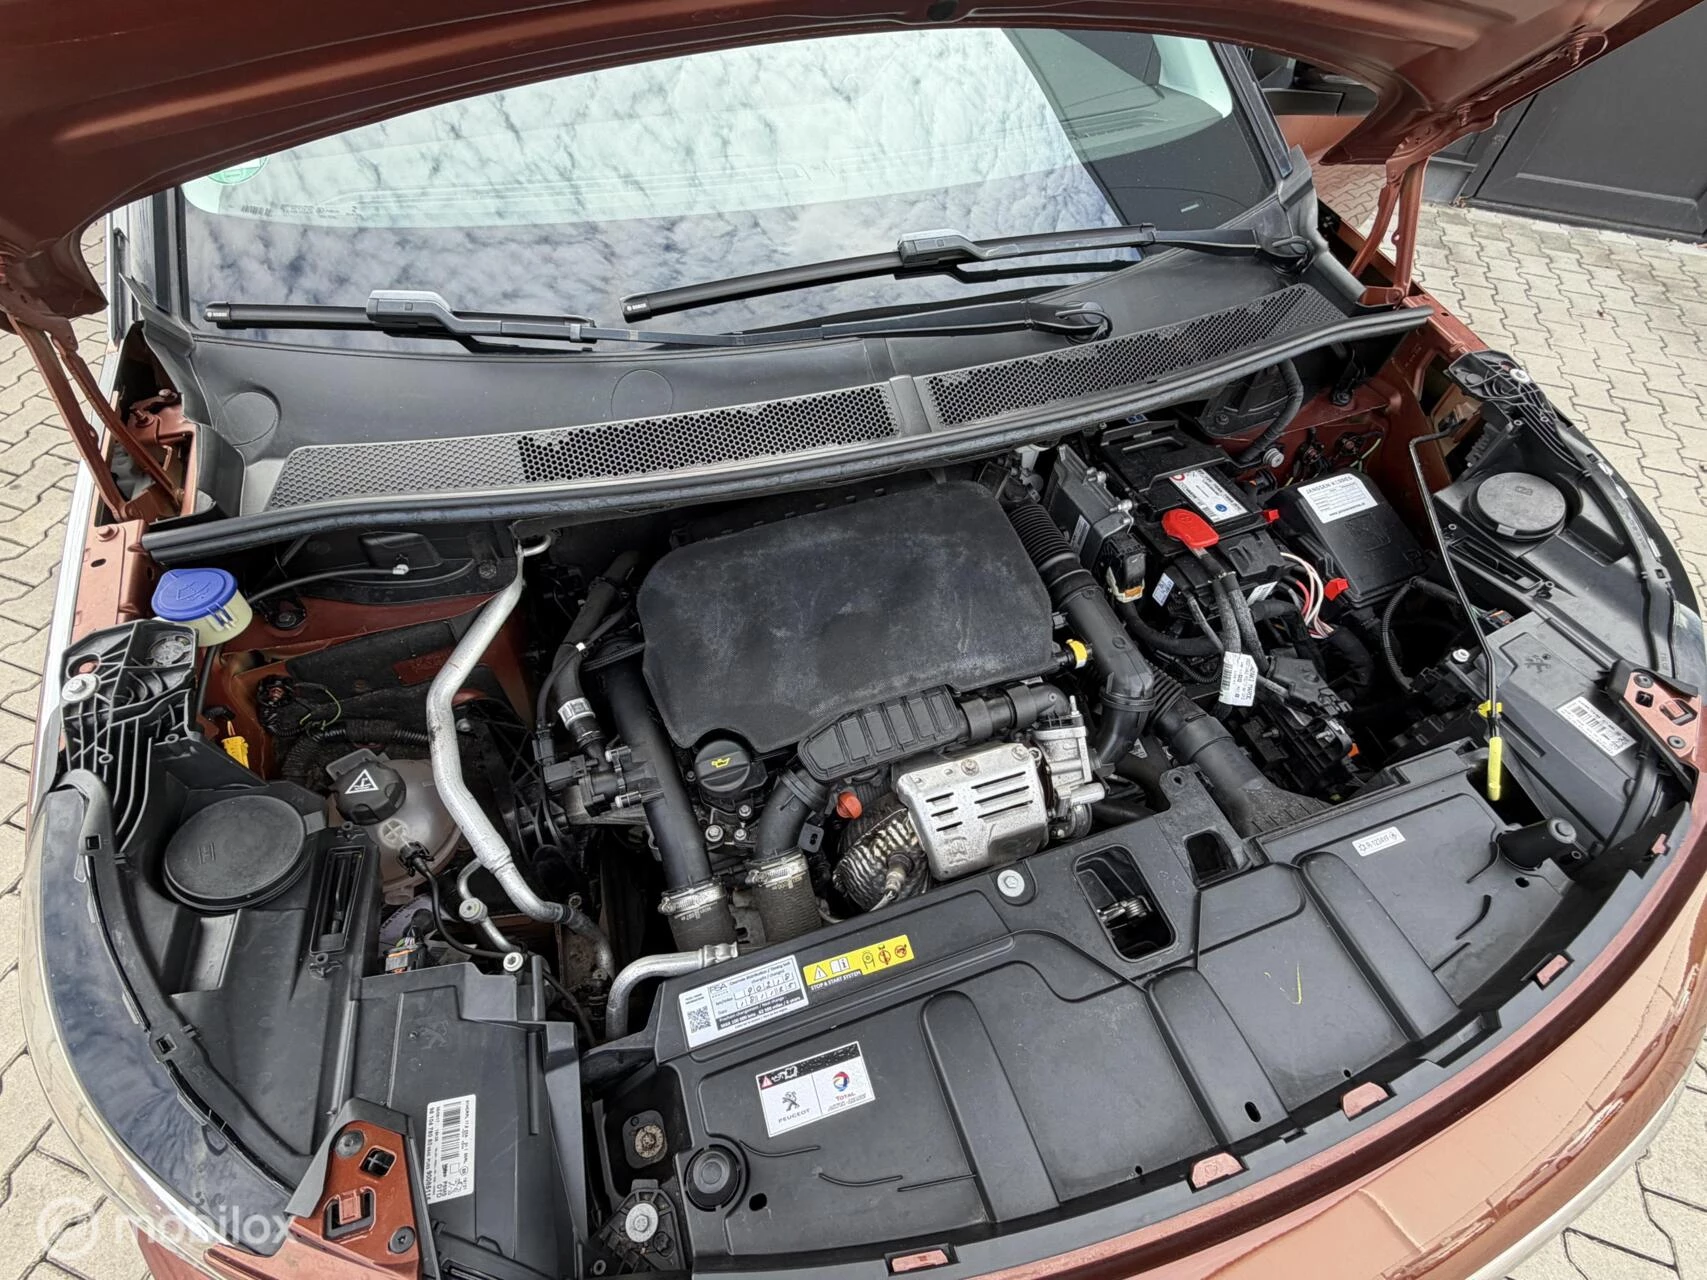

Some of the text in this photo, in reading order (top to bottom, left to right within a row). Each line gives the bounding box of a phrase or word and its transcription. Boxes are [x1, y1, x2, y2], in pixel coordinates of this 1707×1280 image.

[810, 982, 824, 990] STOP
[827, 976, 842, 985] START
[842, 970, 861, 980] SYSTEM
[778, 1108, 810, 1123] PEUGEOT
